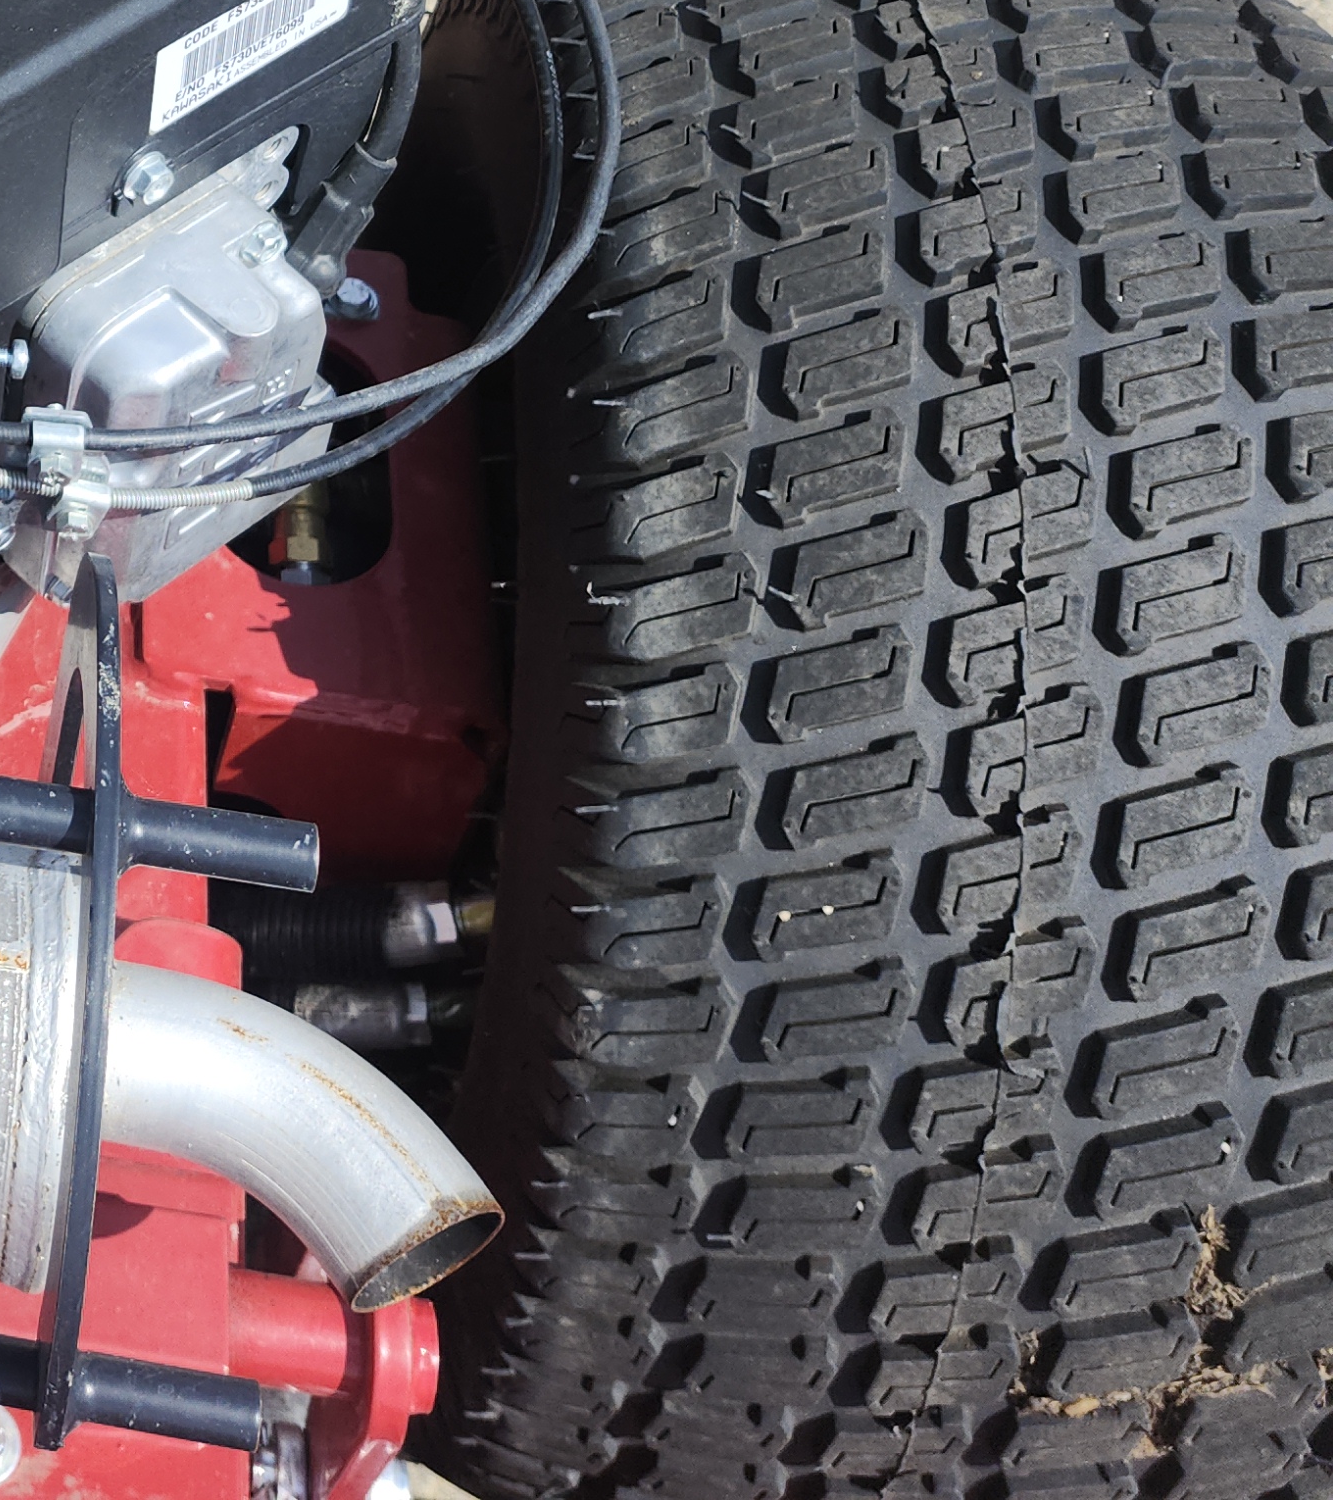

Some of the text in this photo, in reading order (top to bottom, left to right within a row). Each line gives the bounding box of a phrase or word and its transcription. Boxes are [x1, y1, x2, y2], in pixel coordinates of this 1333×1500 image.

[161, 72, 231, 123] KAWASAKI
[234, 39, 288, 79] ASSEMBLED
[294, 29, 306, 41] IN
[175, 14, 305, 103] E/NO FS730VE76099
[184, 20, 219, 50] CODE
